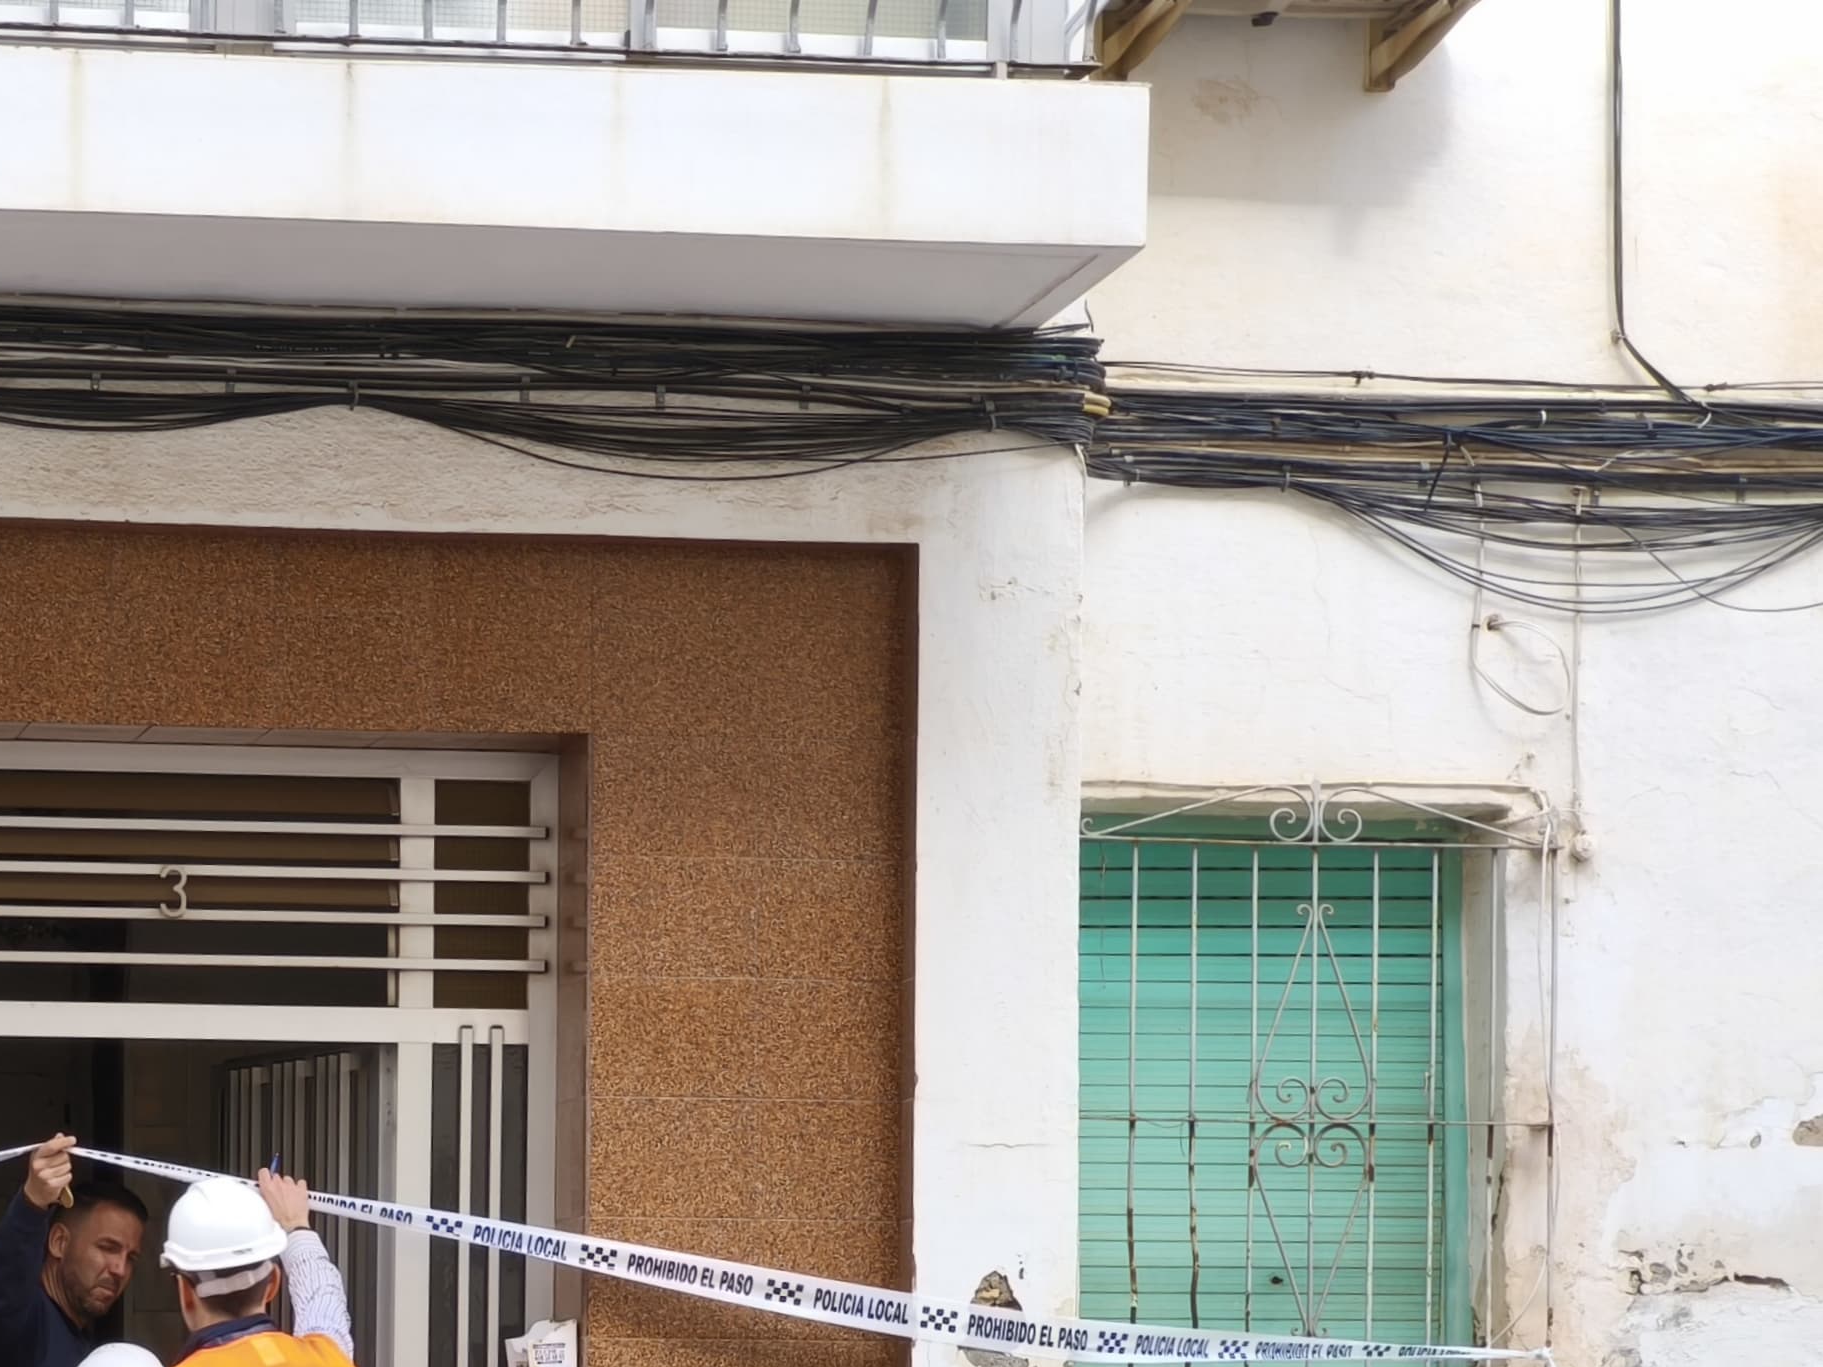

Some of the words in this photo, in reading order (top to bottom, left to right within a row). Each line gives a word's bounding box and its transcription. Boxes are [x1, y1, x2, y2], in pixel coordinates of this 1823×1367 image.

[160, 866, 187, 918] 3
[472, 1224, 523, 1251] POLICIA
[527, 1235, 567, 1261] LOCAL
[626, 1253, 698, 1285] PROHIBIDO
[700, 1267, 716, 1289] EL
[719, 1272, 754, 1296] PASO
[813, 1287, 864, 1316] POLICIA
[867, 1296, 909, 1325] LOCAL
[966, 1313, 1037, 1346] PROHIBIDO
[1039, 1325, 1054, 1348] EL
[1057, 1328, 1090, 1351] PASO
[1133, 1334, 1176, 1357] POLICIA
[1176, 1337, 1211, 1359] LOCAL
